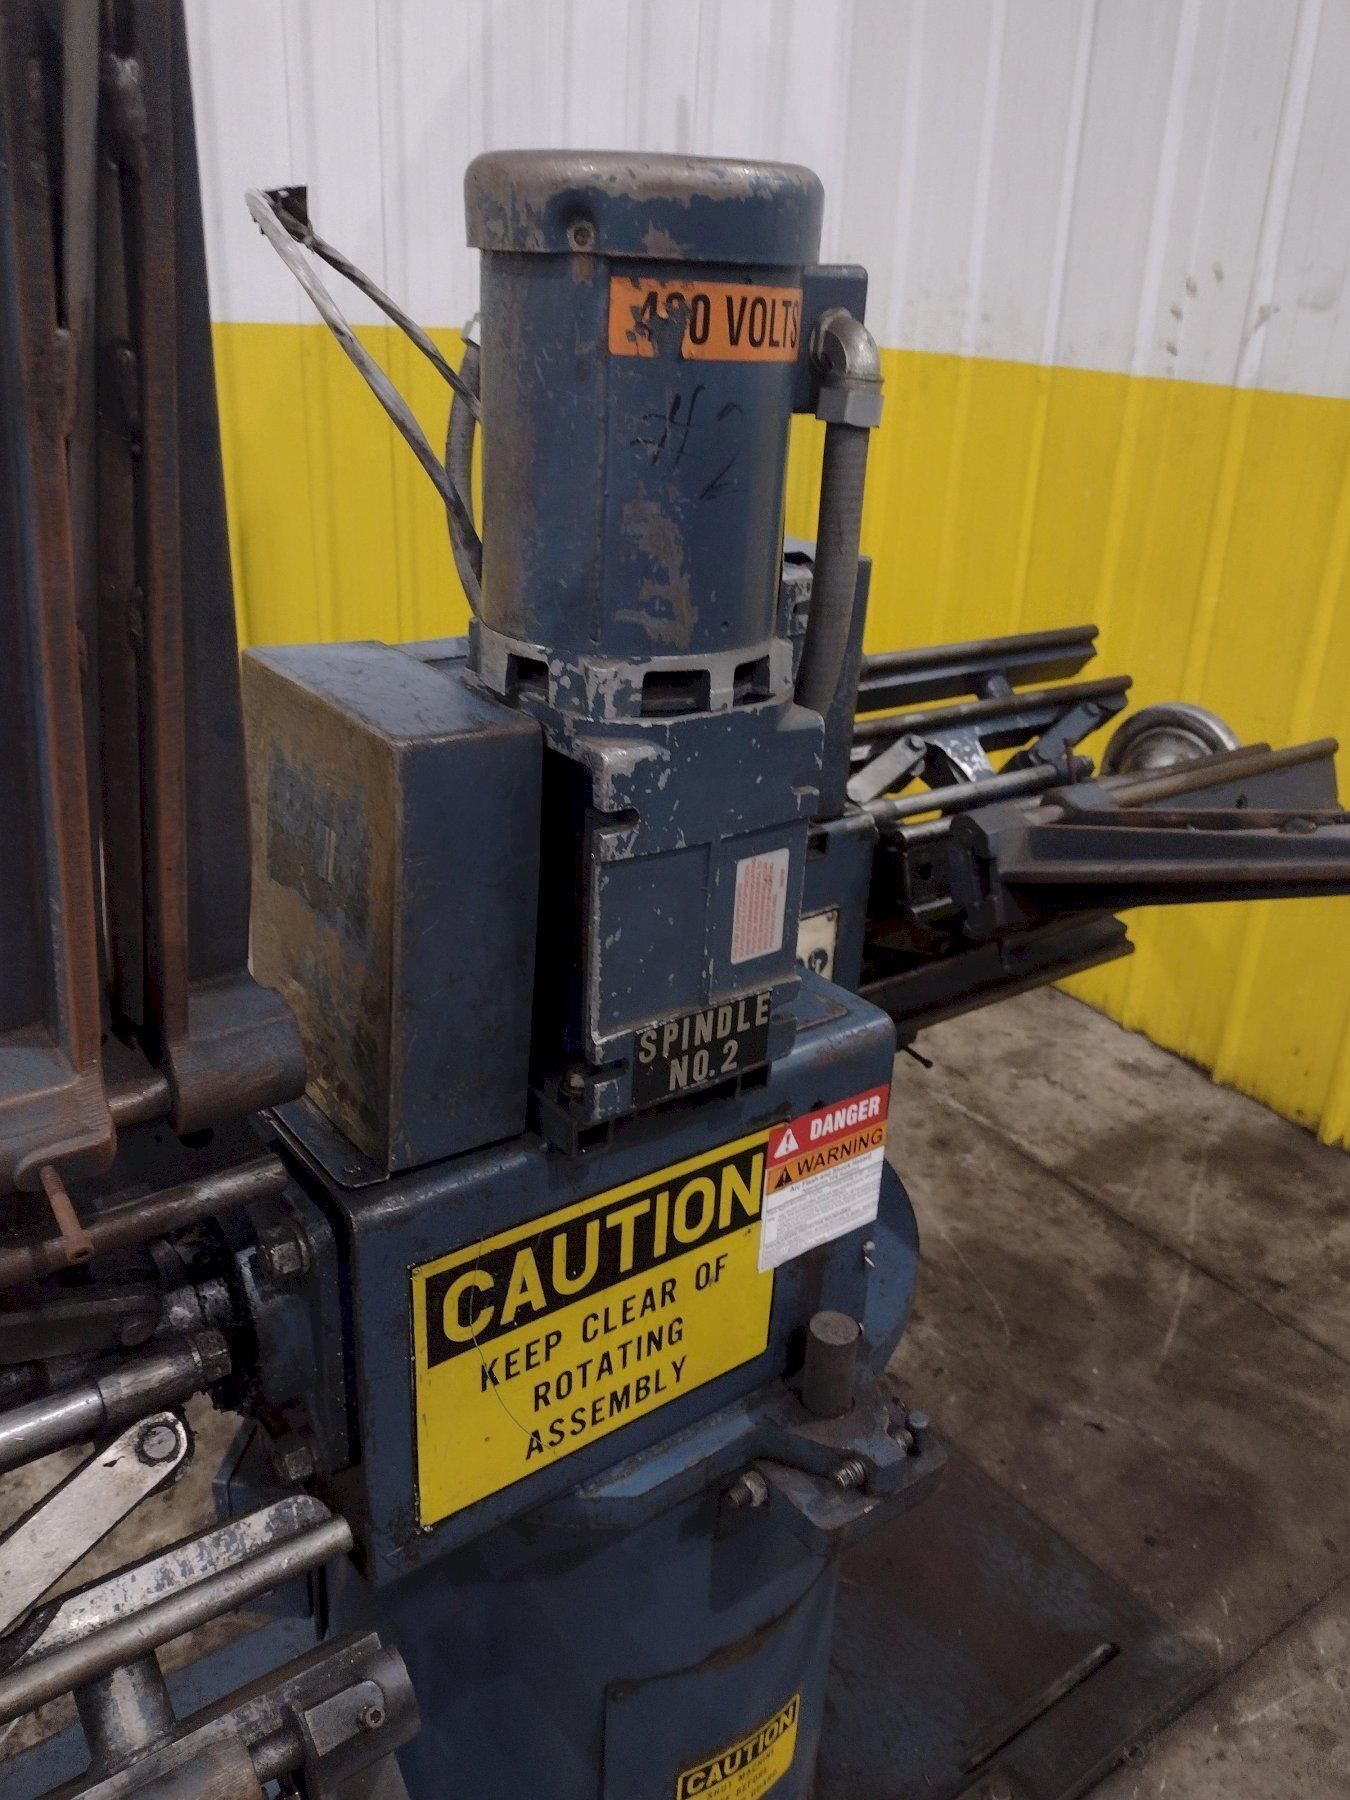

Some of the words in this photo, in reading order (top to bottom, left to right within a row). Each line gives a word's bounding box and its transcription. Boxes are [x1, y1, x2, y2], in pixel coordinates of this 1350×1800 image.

[726, 295, 800, 348] VOLTS
[638, 991, 772, 1064] SPINDLE
[797, 1127, 883, 1176] WARNING
[809, 1095, 881, 1141] DANGER
[443, 1152, 764, 1343] CAUTION
[480, 1329, 562, 1392] KEEP
[581, 1276, 677, 1343] CLEAR
[695, 1253, 728, 1291] OF
[533, 1316, 684, 1412] ROTATING
[525, 1355, 686, 1460] ASSEMBLY
[686, 1704, 794, 1795] CAUTION
